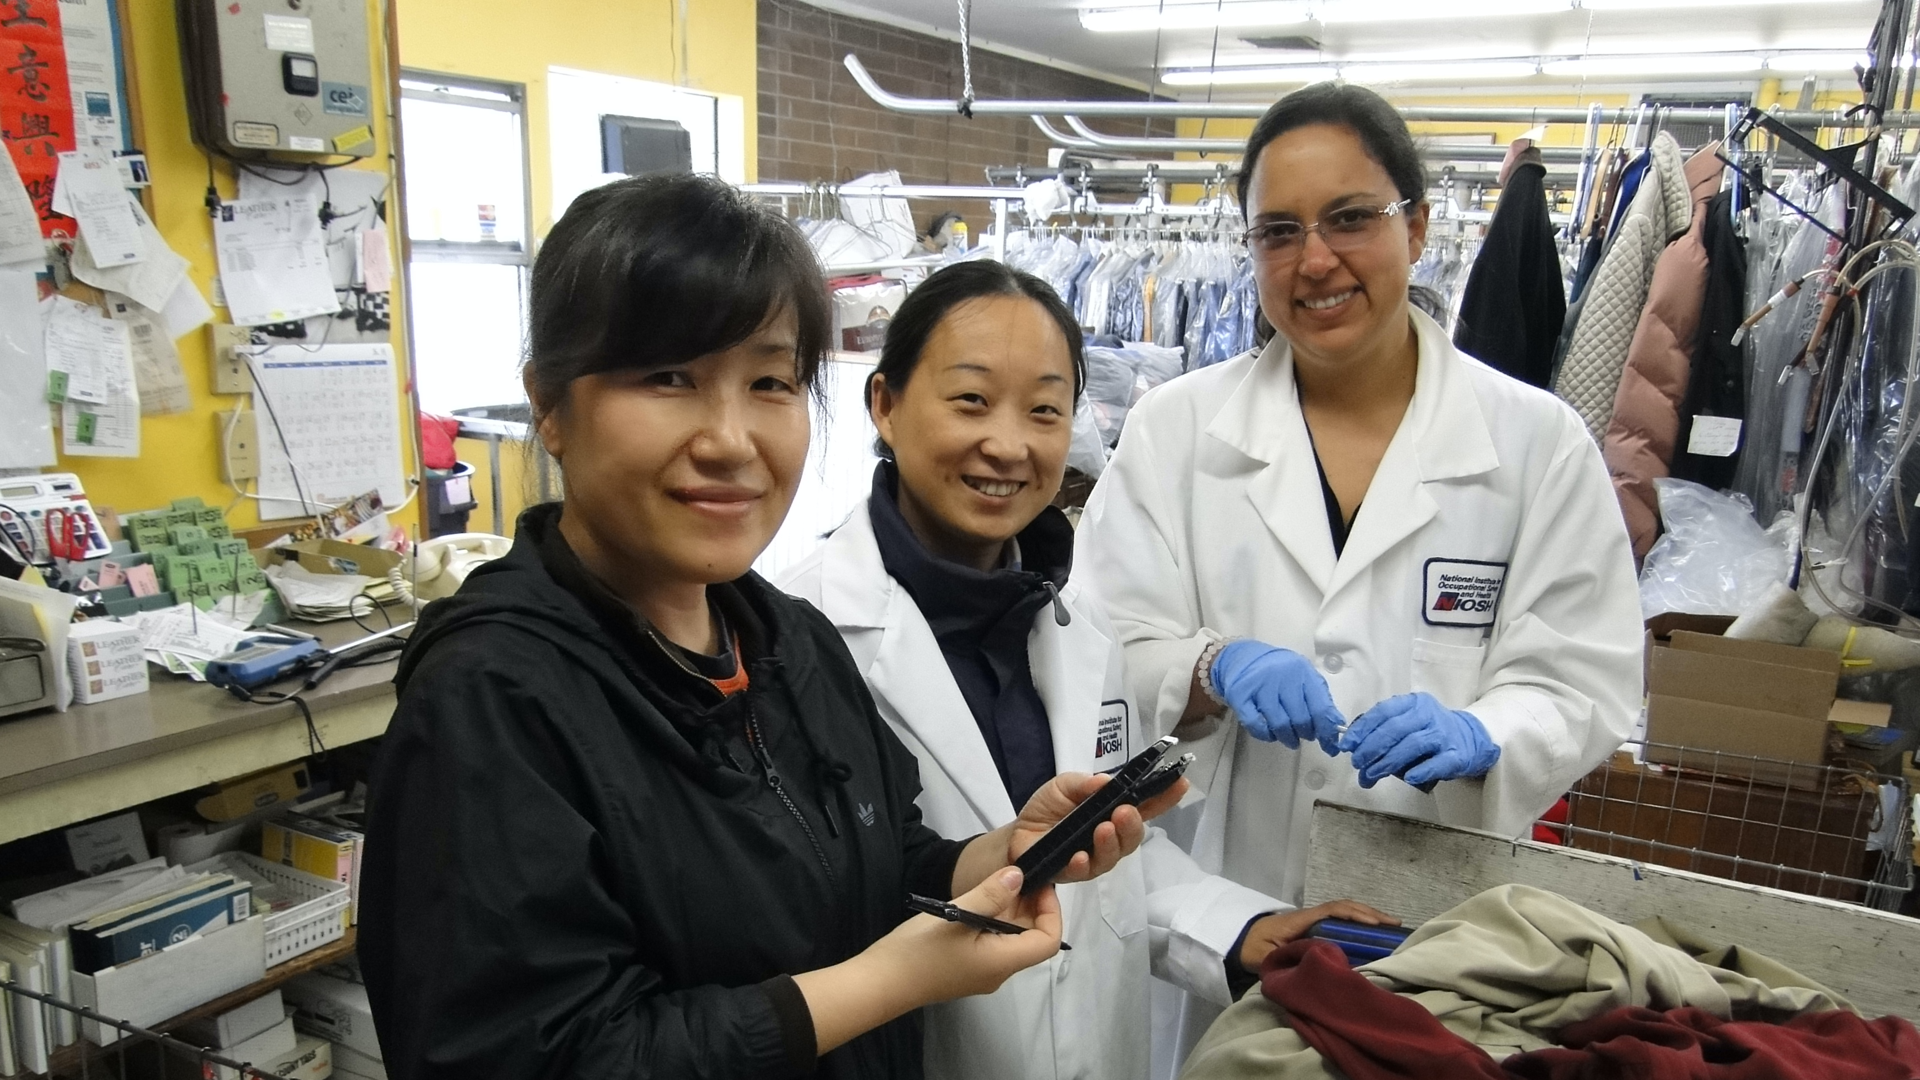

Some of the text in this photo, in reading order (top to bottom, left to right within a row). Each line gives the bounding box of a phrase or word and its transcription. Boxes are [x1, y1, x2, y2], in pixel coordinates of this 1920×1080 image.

[1440, 574, 1475, 583] National
[1438, 582, 1486, 591] Occupational
[1432, 592, 1494, 612] NIOSH
[96, 635, 141, 649] LEATHER
[100, 653, 144, 668] LEATHER
[104, 671, 146, 687] LEATHER
